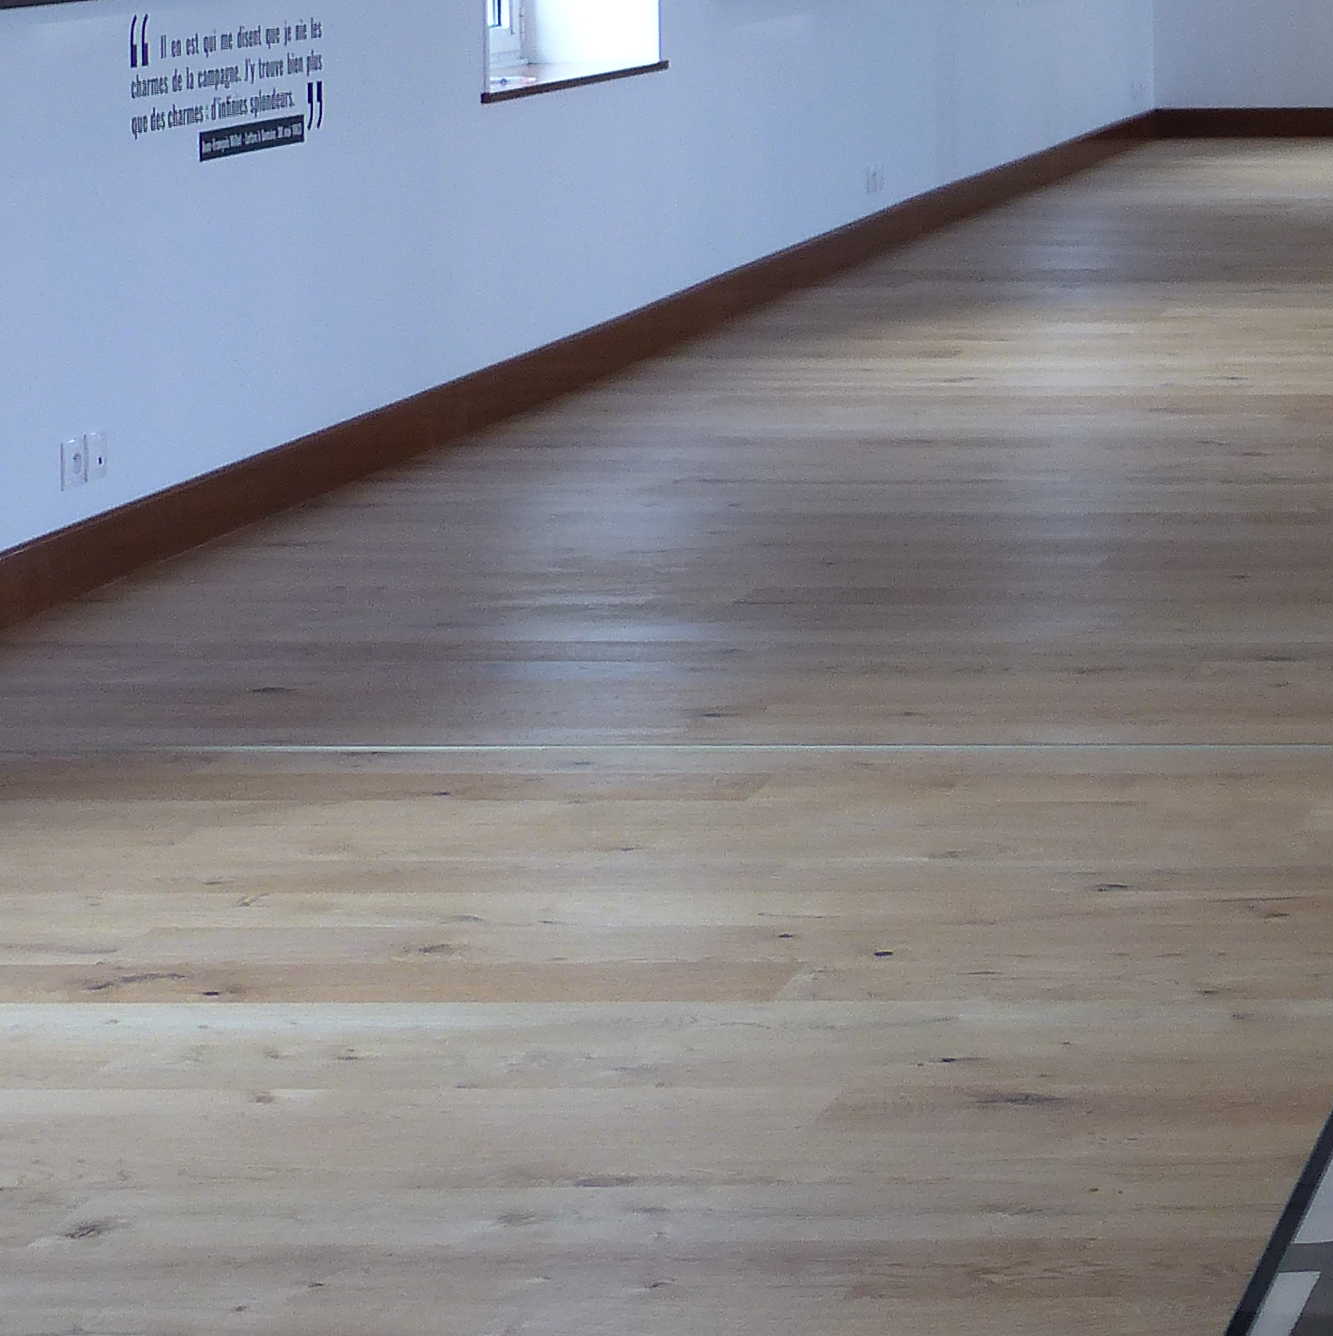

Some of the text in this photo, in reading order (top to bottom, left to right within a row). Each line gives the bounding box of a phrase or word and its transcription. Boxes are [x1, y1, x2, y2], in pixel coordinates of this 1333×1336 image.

[171, 39, 182, 58] en
[186, 32, 200, 56] est
[203, 29, 217, 58] qui
[221, 32, 233, 51] me
[265, 27, 280, 50] que
[284, 21, 292, 46] je
[310, 17, 322, 40] les
[131, 74, 168, 99] charmes
[172, 68, 183, 93] de
[186, 67, 194, 90] la
[258, 56, 284, 80] trouve
[287, 51, 303, 75] bien
[306, 49, 323, 77] plus
[131, 114, 148, 140] que
[150, 107, 165, 132] des
